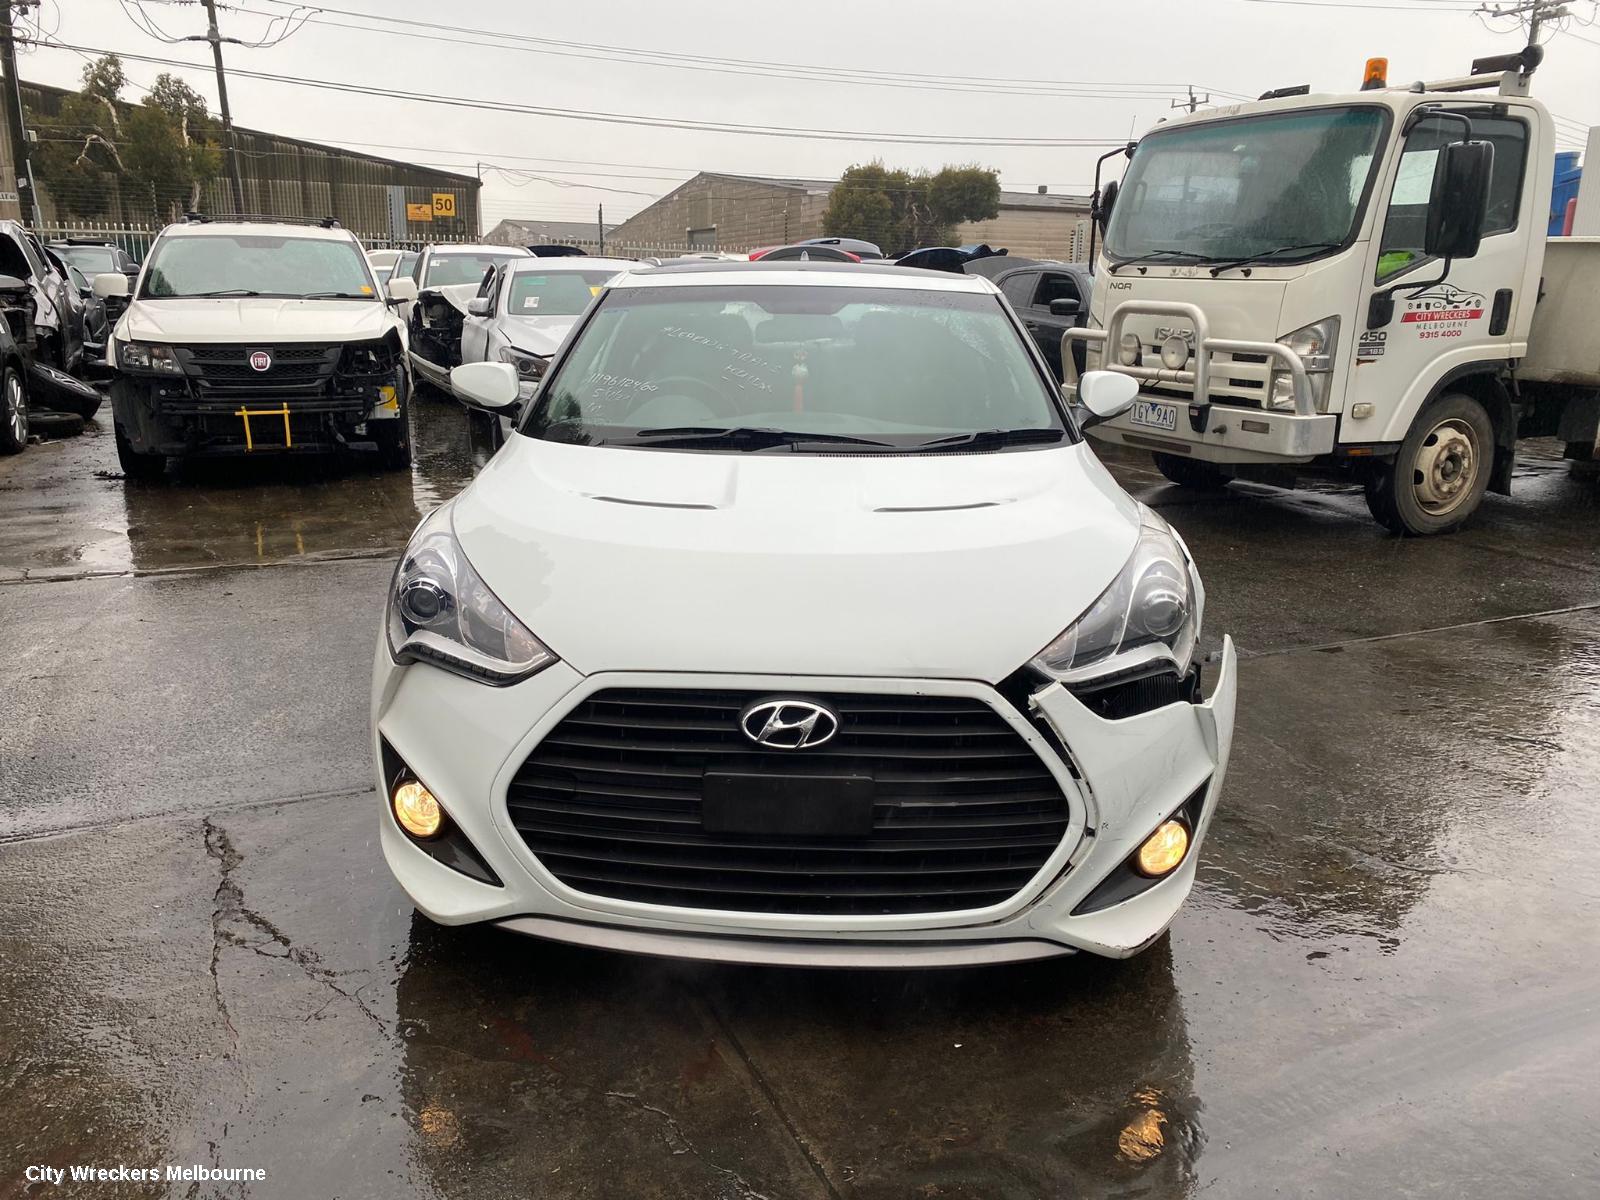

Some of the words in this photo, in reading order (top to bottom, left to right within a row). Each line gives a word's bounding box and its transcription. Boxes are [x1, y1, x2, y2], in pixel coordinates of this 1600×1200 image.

[435, 198, 452, 211] 50
[1109, 282, 1132, 290] NQR
[1415, 312, 1432, 321] CITY
[1433, 310, 1471, 320] WRECKERS
[1416, 320, 1468, 330] MELBOURNE
[1359, 331, 1387, 342] 450
[1419, 331, 1439, 339] 9315
[254, 357, 267, 367] FIAT
[1132, 403, 1150, 420] 1GY
